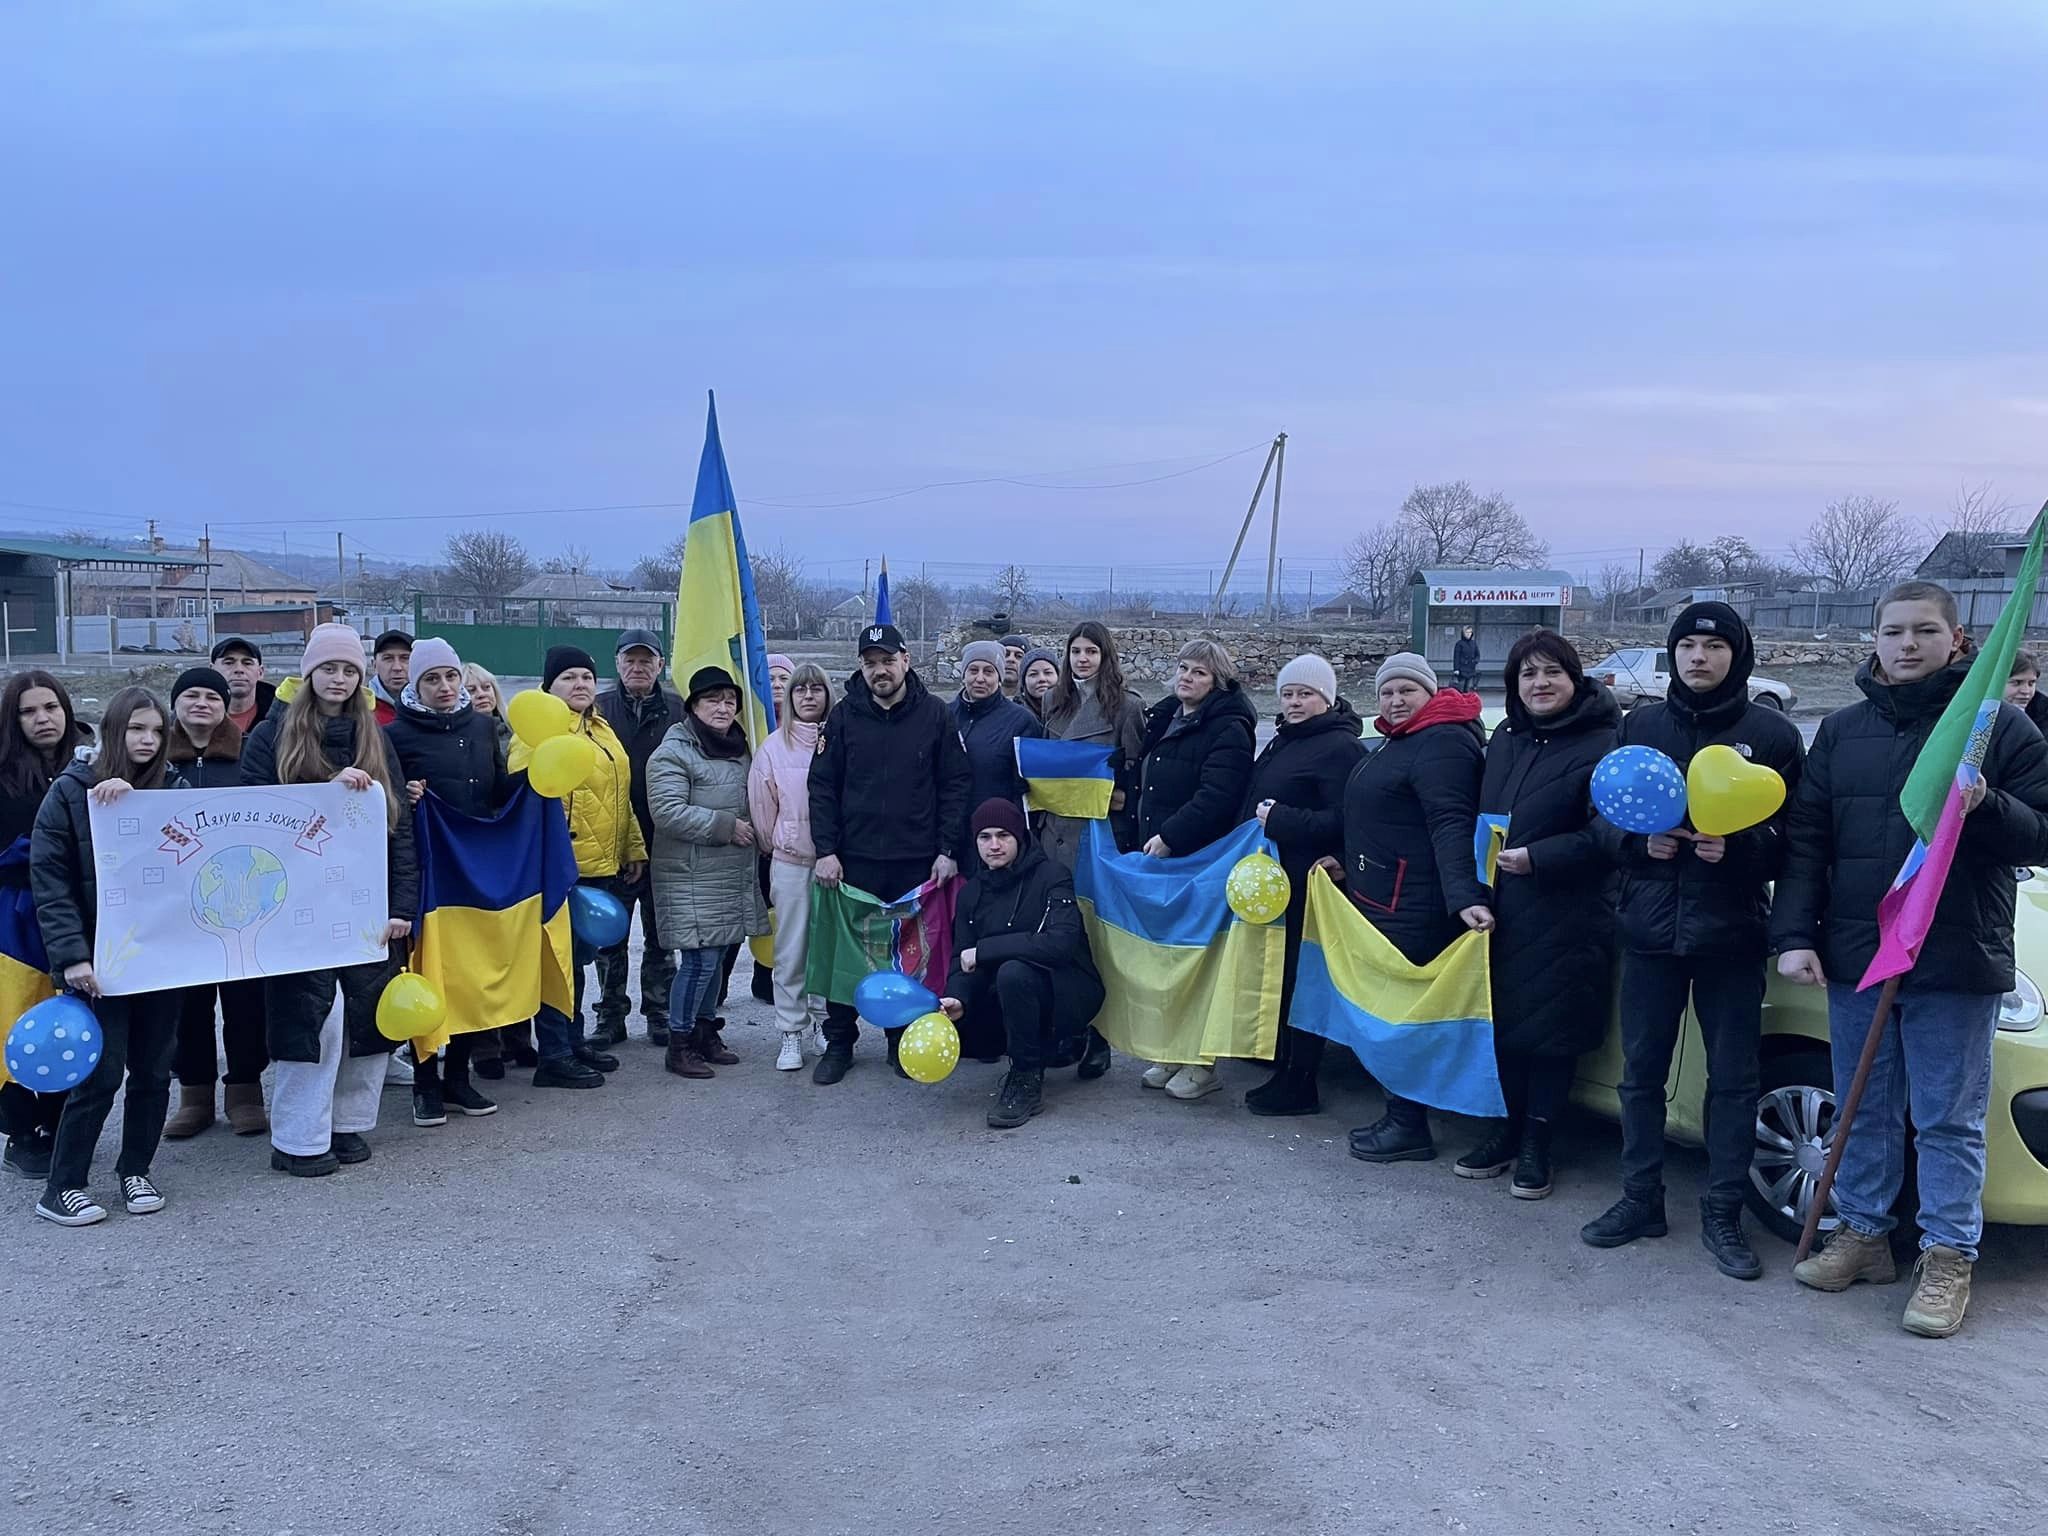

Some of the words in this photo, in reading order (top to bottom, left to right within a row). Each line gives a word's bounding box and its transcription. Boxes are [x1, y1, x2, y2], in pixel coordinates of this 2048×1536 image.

[1454, 590, 1528, 602] АДЖАМКА
[1530, 591, 1555, 599] ЦЕНТР
[195, 810, 241, 832] Дякую
[244, 811, 260, 822] за
[265, 812, 307, 831] захист
